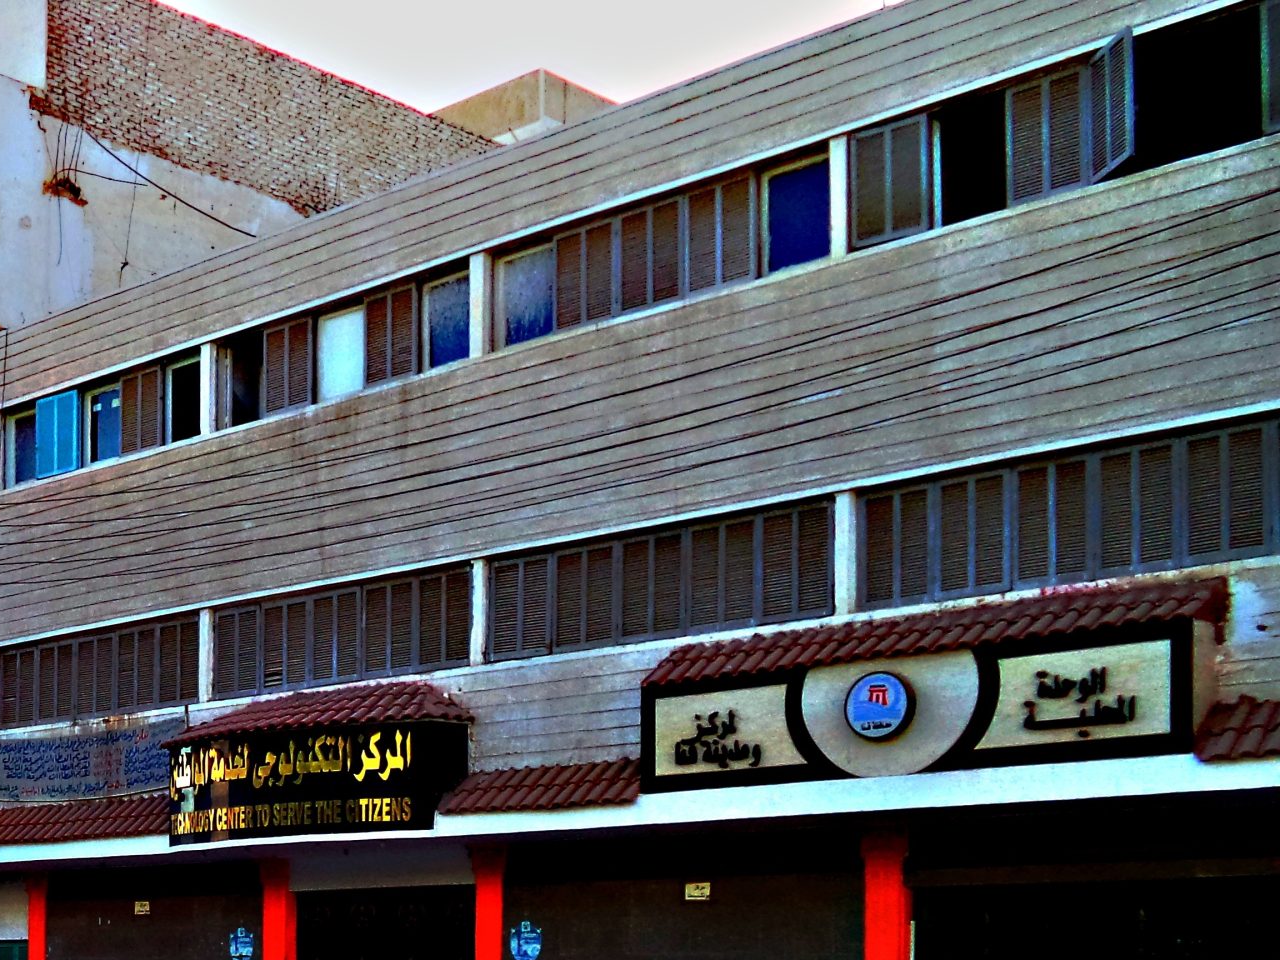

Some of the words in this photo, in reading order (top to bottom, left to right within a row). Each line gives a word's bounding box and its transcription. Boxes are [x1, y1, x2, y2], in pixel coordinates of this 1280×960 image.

[1036, 667, 1107, 703] الوحدة
[1023, 695, 1136, 738] المحلية
[209, 743, 248, 782] لخدمة
[353, 729, 411, 782] المركز
[700, 740, 762, 768] ومدينة
[170, 747, 209, 802] المواطنين
[171, 808, 214, 835] TECHNOLOGY
[216, 806, 253, 831] CENTER
[255, 804, 270, 827] TO
[273, 801, 312, 826] SERVE
[315, 800, 342, 824] THE
[346, 797, 411, 822] CITIZENS
